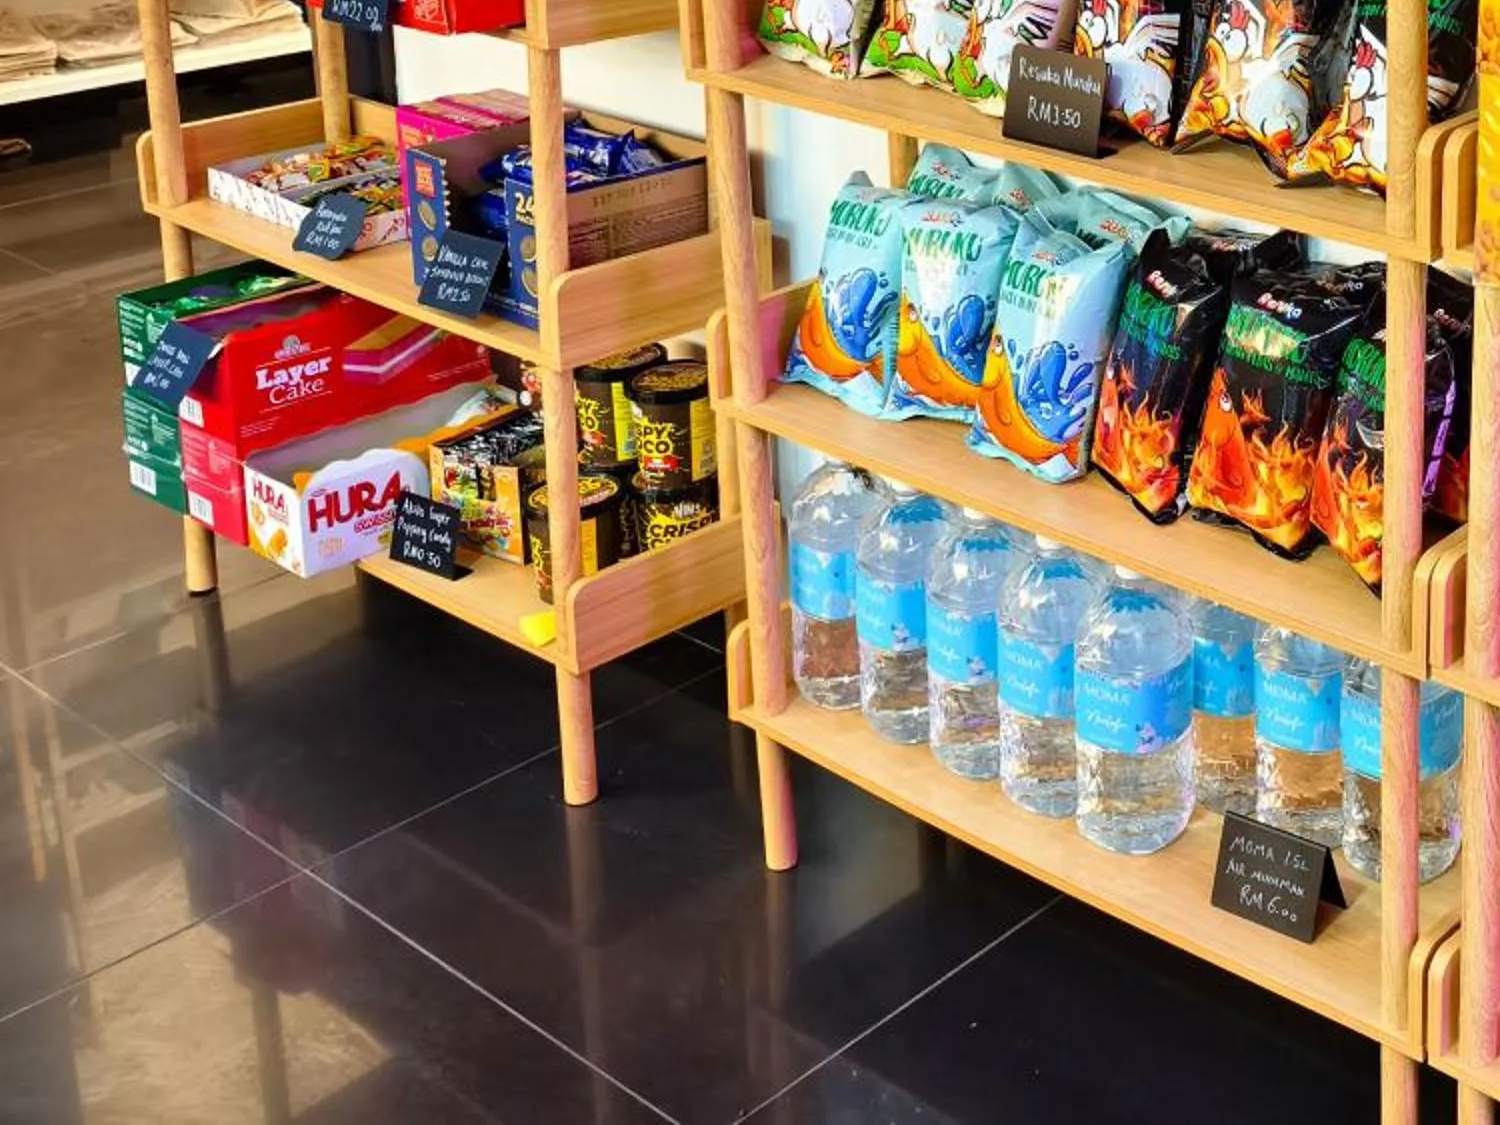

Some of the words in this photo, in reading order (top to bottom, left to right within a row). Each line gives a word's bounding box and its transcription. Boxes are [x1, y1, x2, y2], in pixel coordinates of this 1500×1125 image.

[256, 357, 333, 390] Layer
[269, 377, 325, 405] Cake
[252, 480, 286, 515] HURA
[306, 471, 402, 533] HURA
[1229, 835, 1275, 863] MOMA
